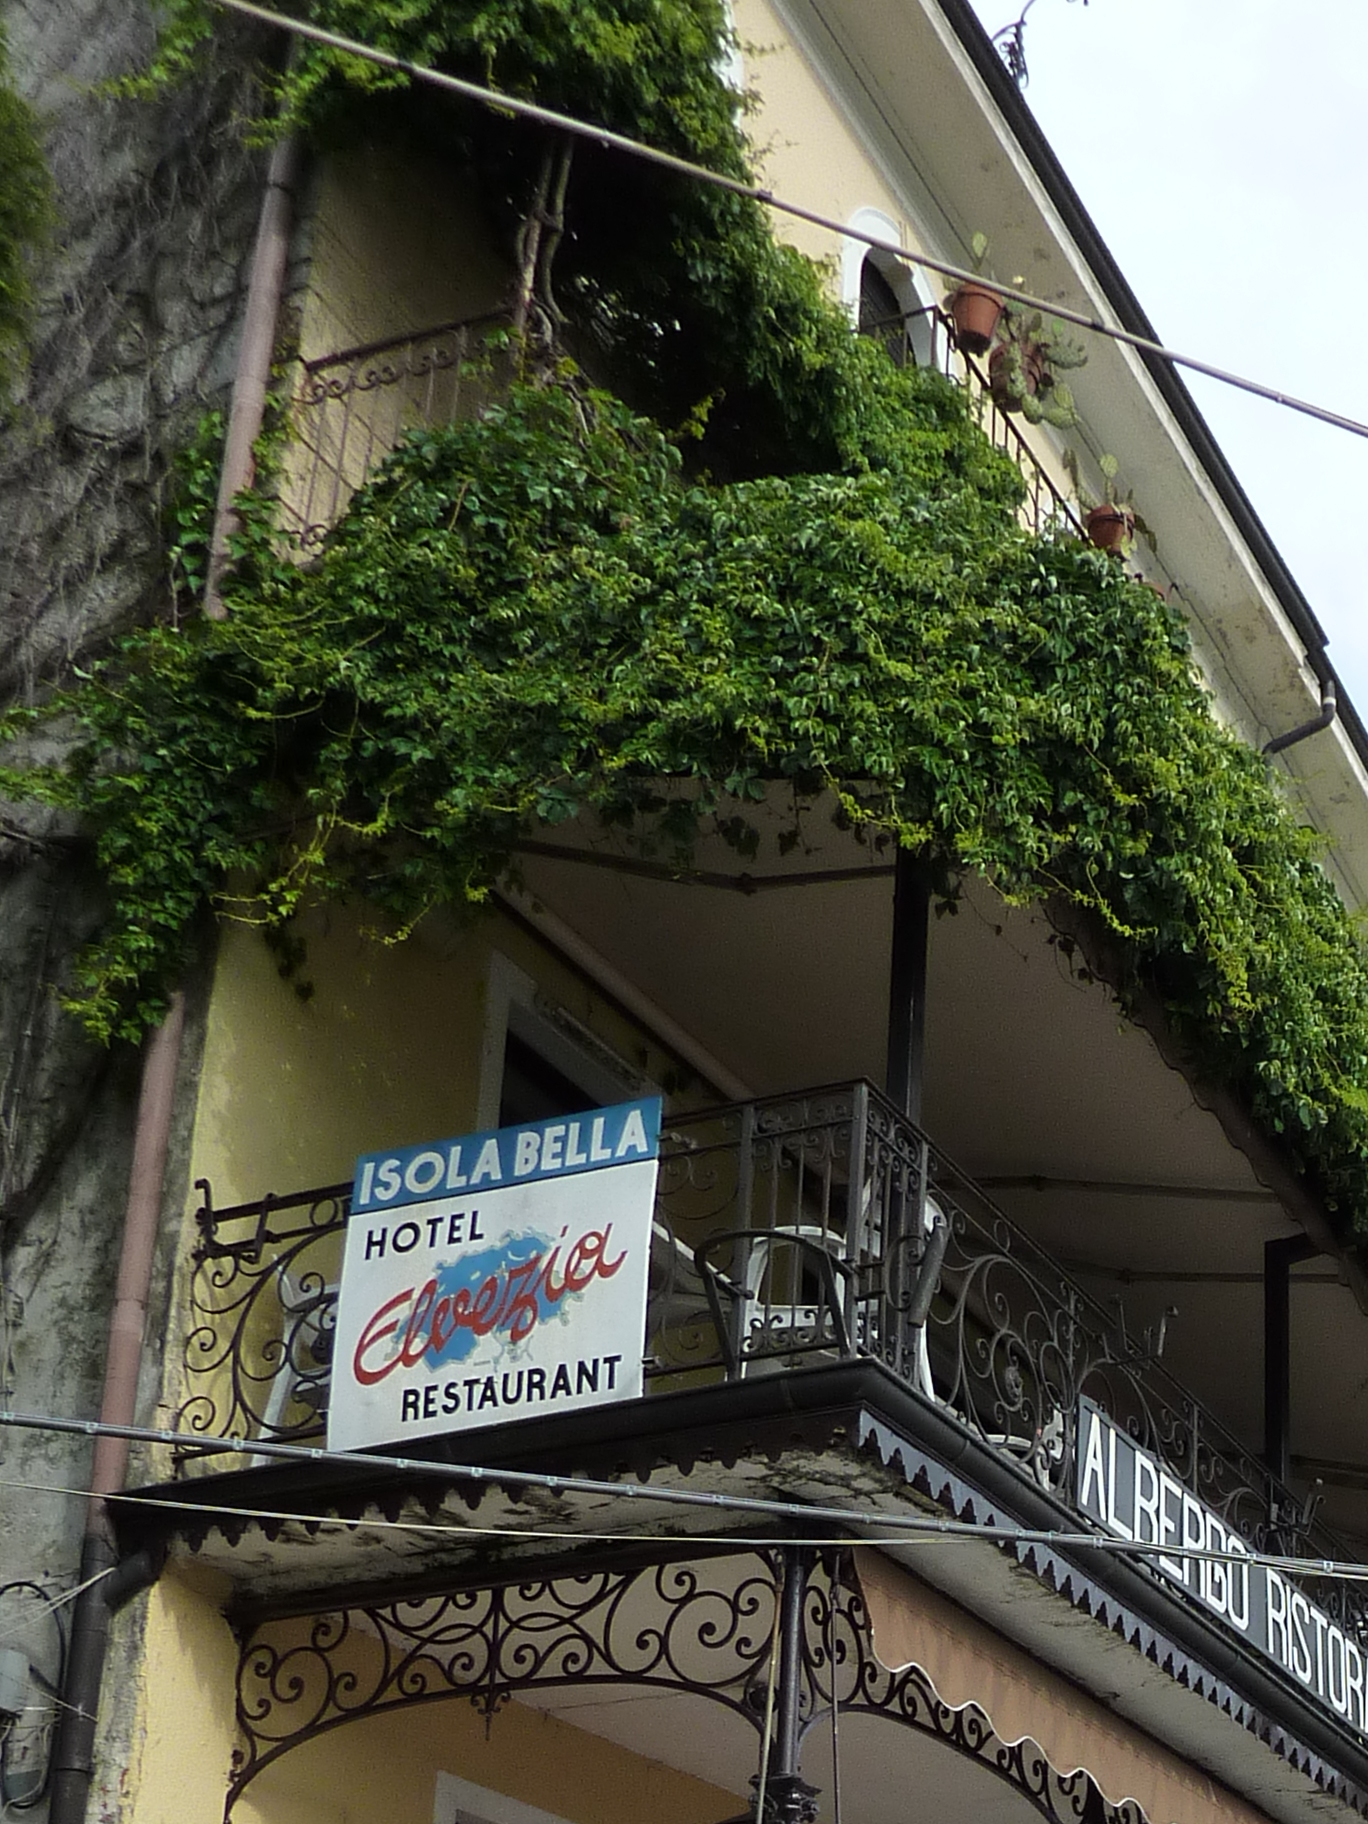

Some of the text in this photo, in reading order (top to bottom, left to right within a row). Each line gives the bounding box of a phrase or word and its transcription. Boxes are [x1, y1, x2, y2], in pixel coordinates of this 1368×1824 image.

[359, 1109, 649, 1205] ISOLA BELLA
[364, 1210, 485, 1260] HOTEL
[353, 1222, 628, 1387] Elvezia
[401, 1355, 623, 1423] RESTAURANT
[1081, 1412, 1249, 1631] ALBERGO
